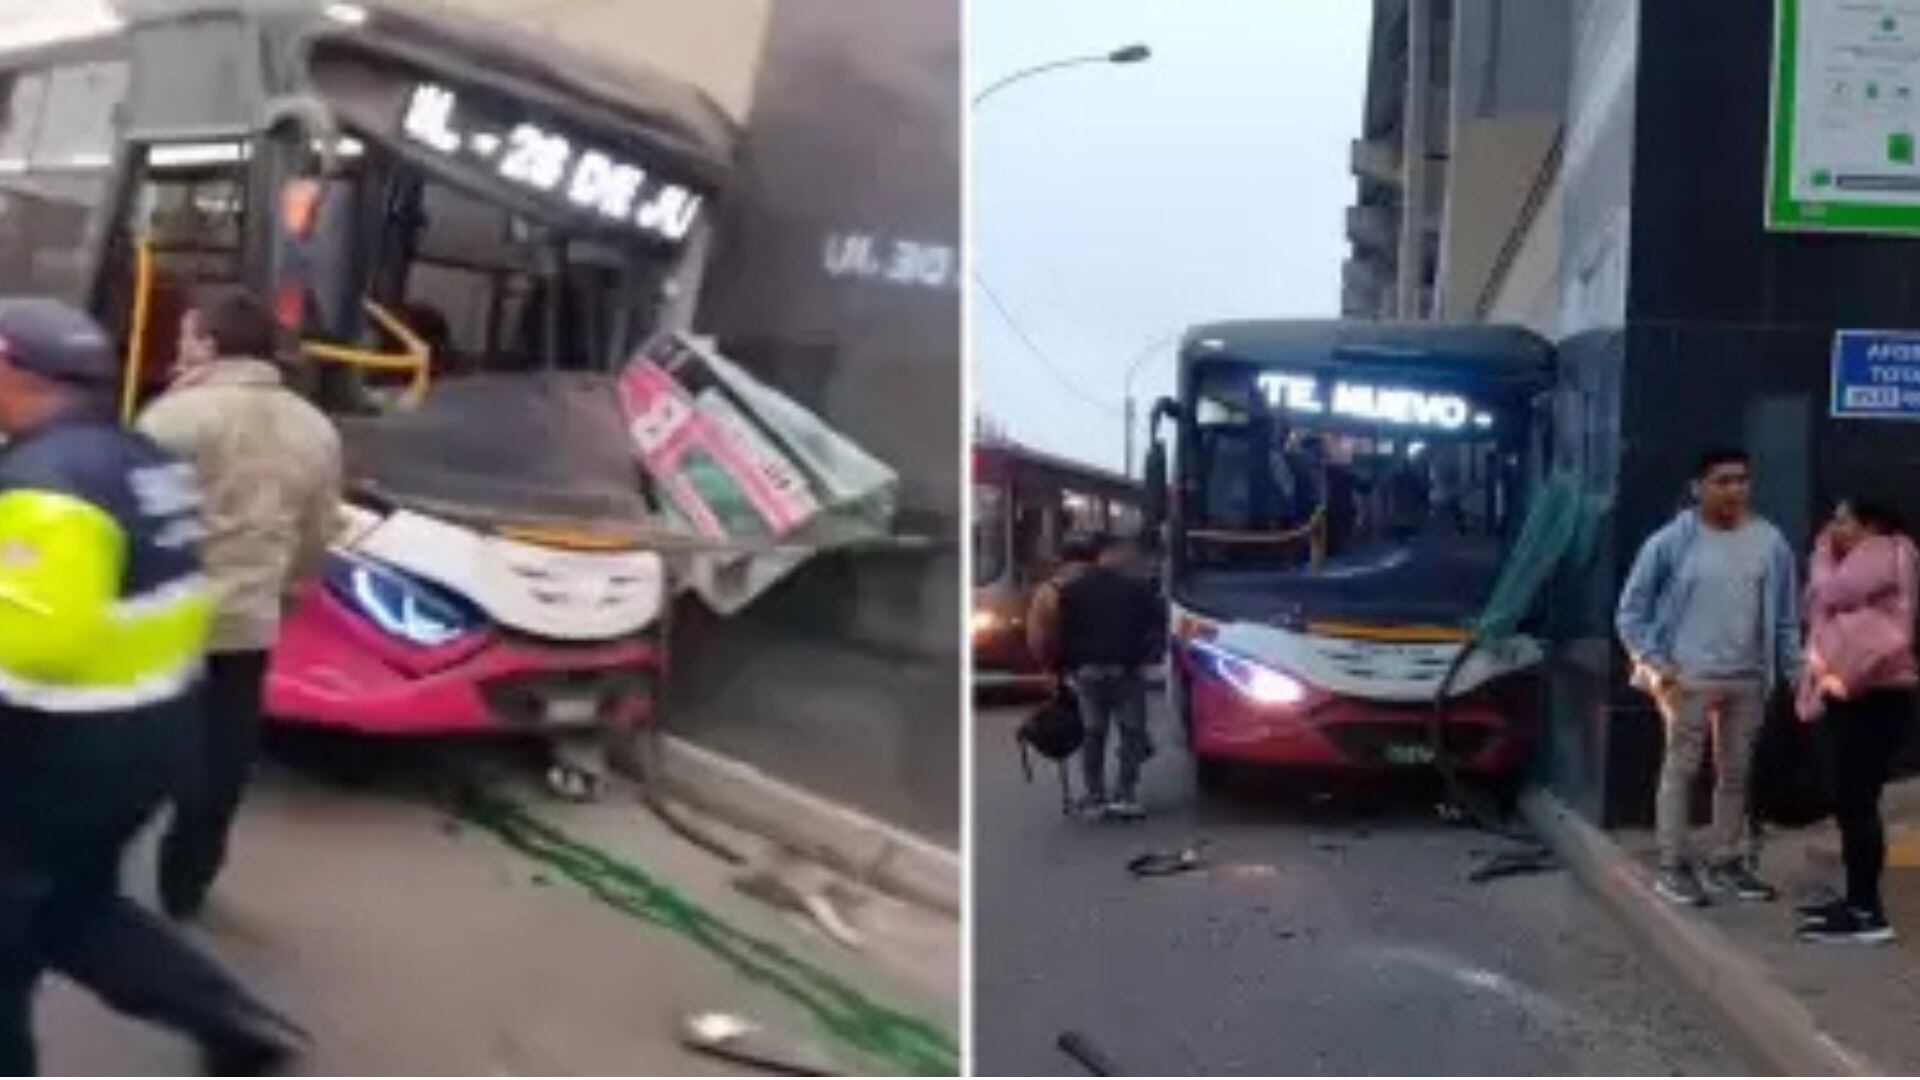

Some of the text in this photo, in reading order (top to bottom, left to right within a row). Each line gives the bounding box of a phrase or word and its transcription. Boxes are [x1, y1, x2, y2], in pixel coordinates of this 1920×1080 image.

[498, 123, 571, 190] 28
[566, 149, 645, 219] DE
[1330, 381, 1468, 430] NUEVO
